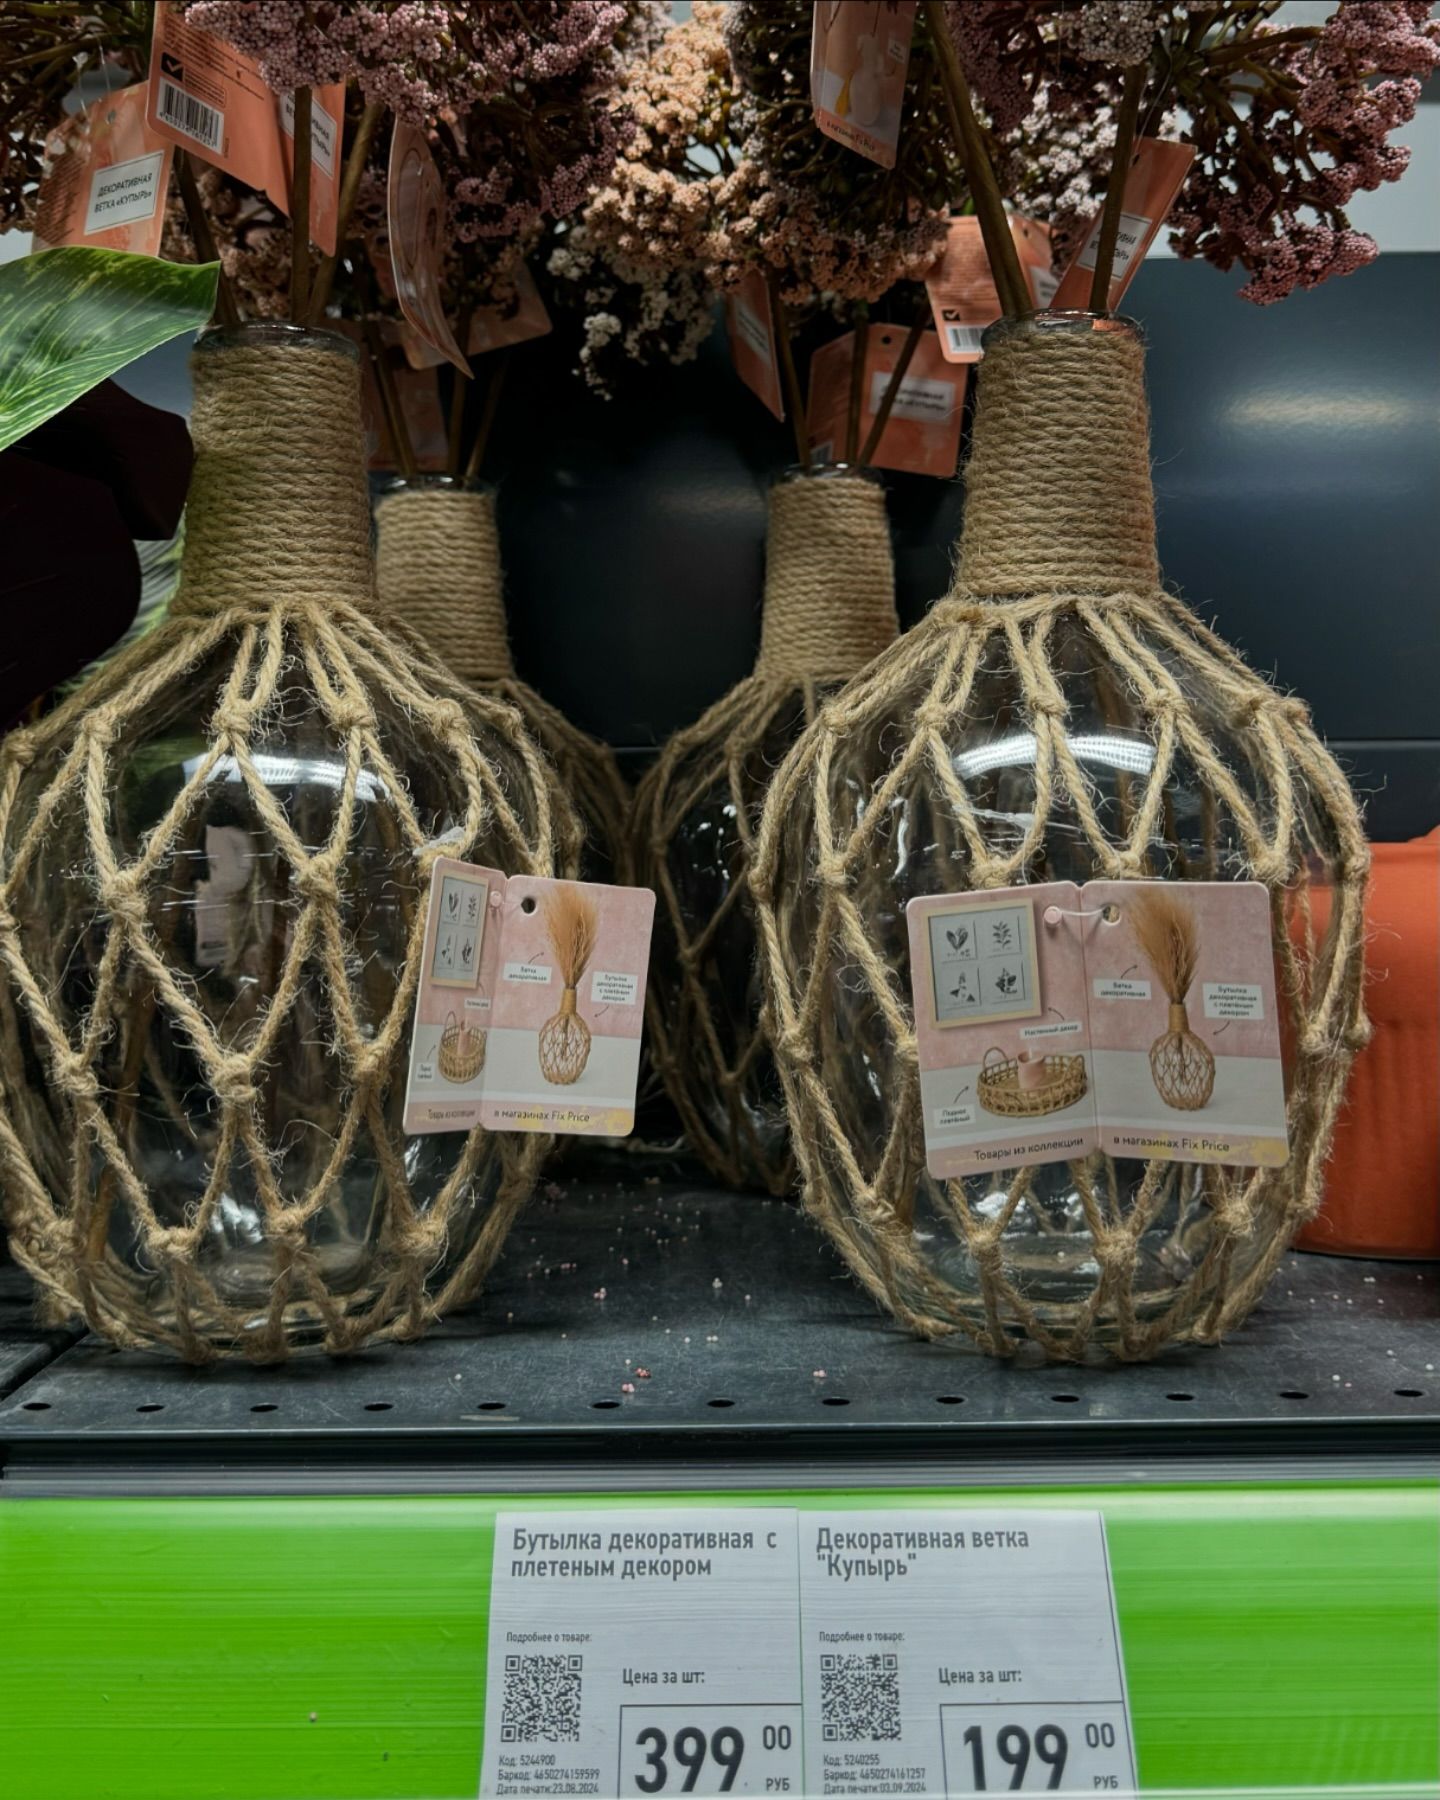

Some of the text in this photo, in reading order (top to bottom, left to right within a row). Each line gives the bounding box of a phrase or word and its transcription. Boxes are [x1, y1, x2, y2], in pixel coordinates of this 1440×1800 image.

[98, 173, 153, 197] ДЕКОРАТИВНАЯ
[94, 199, 115, 213] ВЕТКА
[502, 1110, 549, 1120] магазинах
[551, 1110, 566, 1121] Fix
[568, 1111, 590, 1122] Price
[974, 1137, 1084, 1161] Товары из коллекции
[1113, 1136, 1230, 1152] в магазинах Fix Price
[513, 1528, 777, 1555] Бутылка декоративная с
[816, 1527, 1029, 1553] Декоративная ветка
[511, 1558, 712, 1581] плетеным декором
[817, 1553, 917, 1582] "Купырь"
[506, 1632, 593, 1644] Подробнее о товаре:
[819, 1631, 905, 1644] Подробнее о товаре:
[622, 1668, 705, 1687] Цена за шт:
[938, 1667, 1022, 1686] Цена за шт:
[498, 1754, 556, 1767] Код: 5244900
[634, 1725, 792, 1793] 399 00
[823, 1753, 880, 1767] Код: 5240255
[963, 1722, 1116, 1791] 199 00
[497, 1768, 600, 1782] Баркод: 4650274159599
[823, 1767, 926, 1782] Баркод: 4650274161257
[1093, 1775, 1119, 1789] РУБ
[496, 1783, 518, 1796] Дата
[766, 1777, 790, 1791] РУБ
[823, 1783, 846, 1796] Дата
